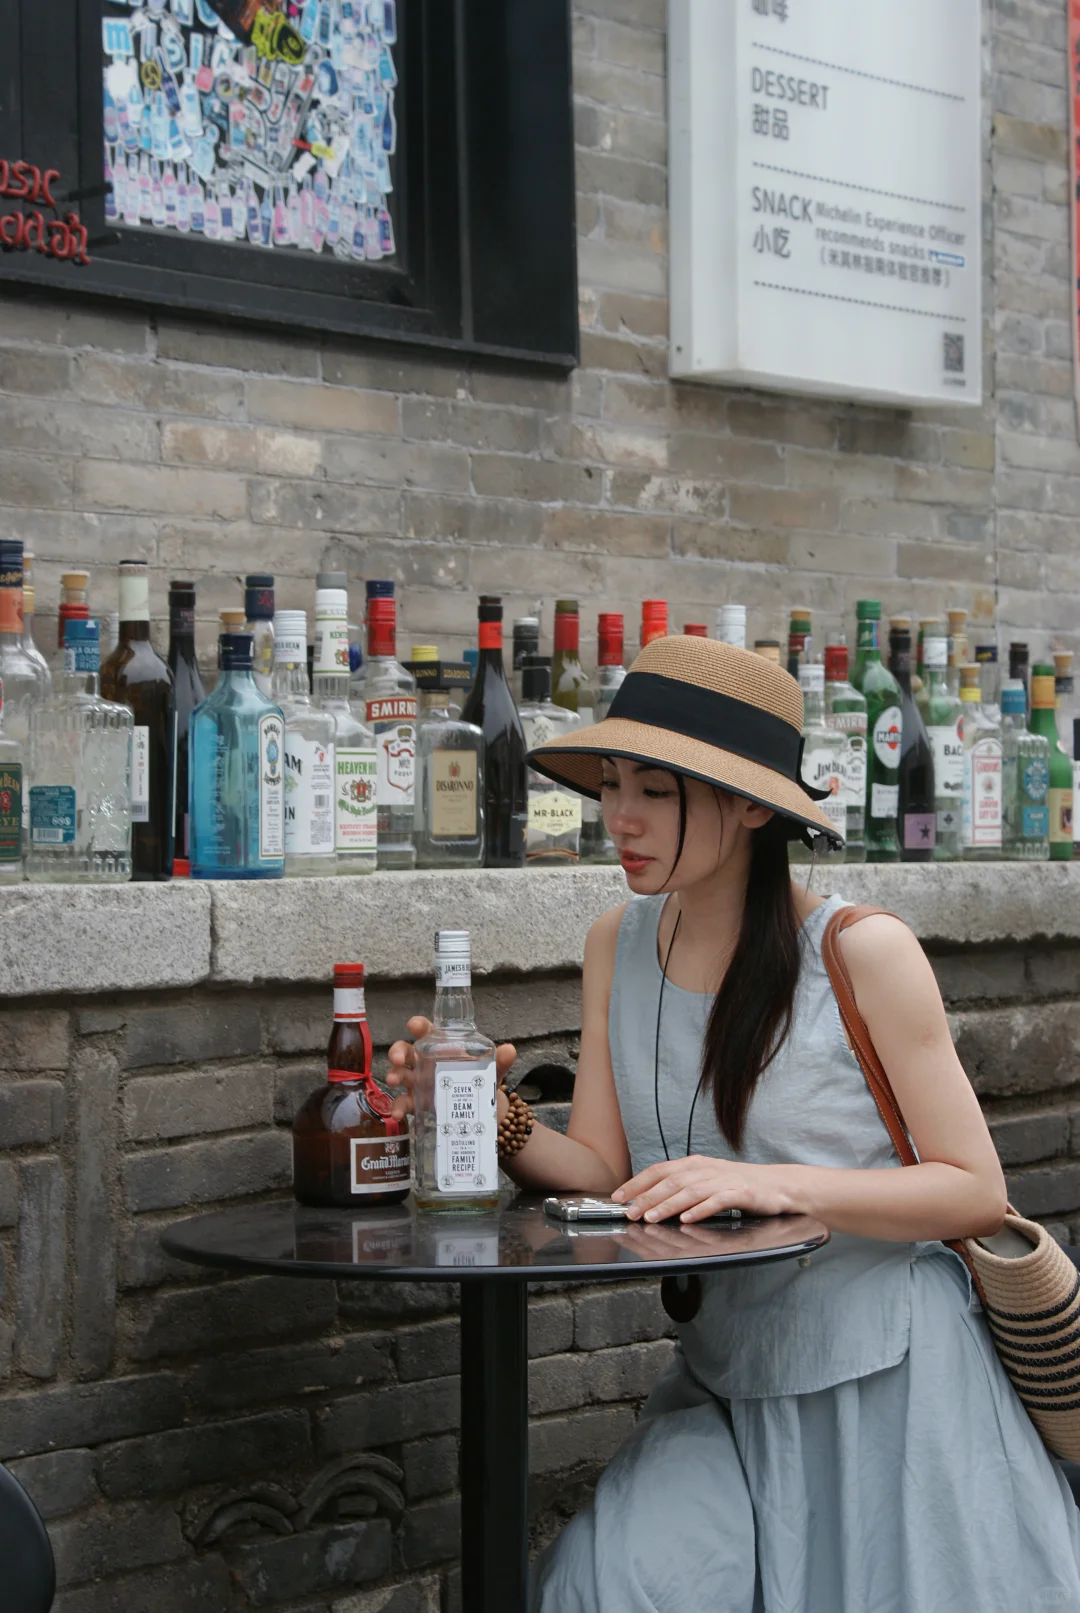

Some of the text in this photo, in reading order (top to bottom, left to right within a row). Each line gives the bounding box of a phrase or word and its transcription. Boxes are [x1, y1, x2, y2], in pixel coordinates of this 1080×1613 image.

[752, 66, 829, 110] DESSERT
[752, 103, 789, 140] 甜品
[752, 186, 813, 223] SNACK
[815, 201, 966, 246] Michelin Experience Officer
[752, 224, 791, 259] 小吃
[815, 226, 885, 252] recommends
[888, 239, 925, 260] snacks
[337, 761, 367, 775] HEAVEN
[813, 762, 831, 781] JIM
[436, 780, 474, 792] DISARONNO
[451, 1110, 475, 1119] FAMILY
[453, 1102, 472, 1110] BEAM
[451, 1155, 475, 1164] FAMILY
[452, 1163, 475, 1172] RECIPE
